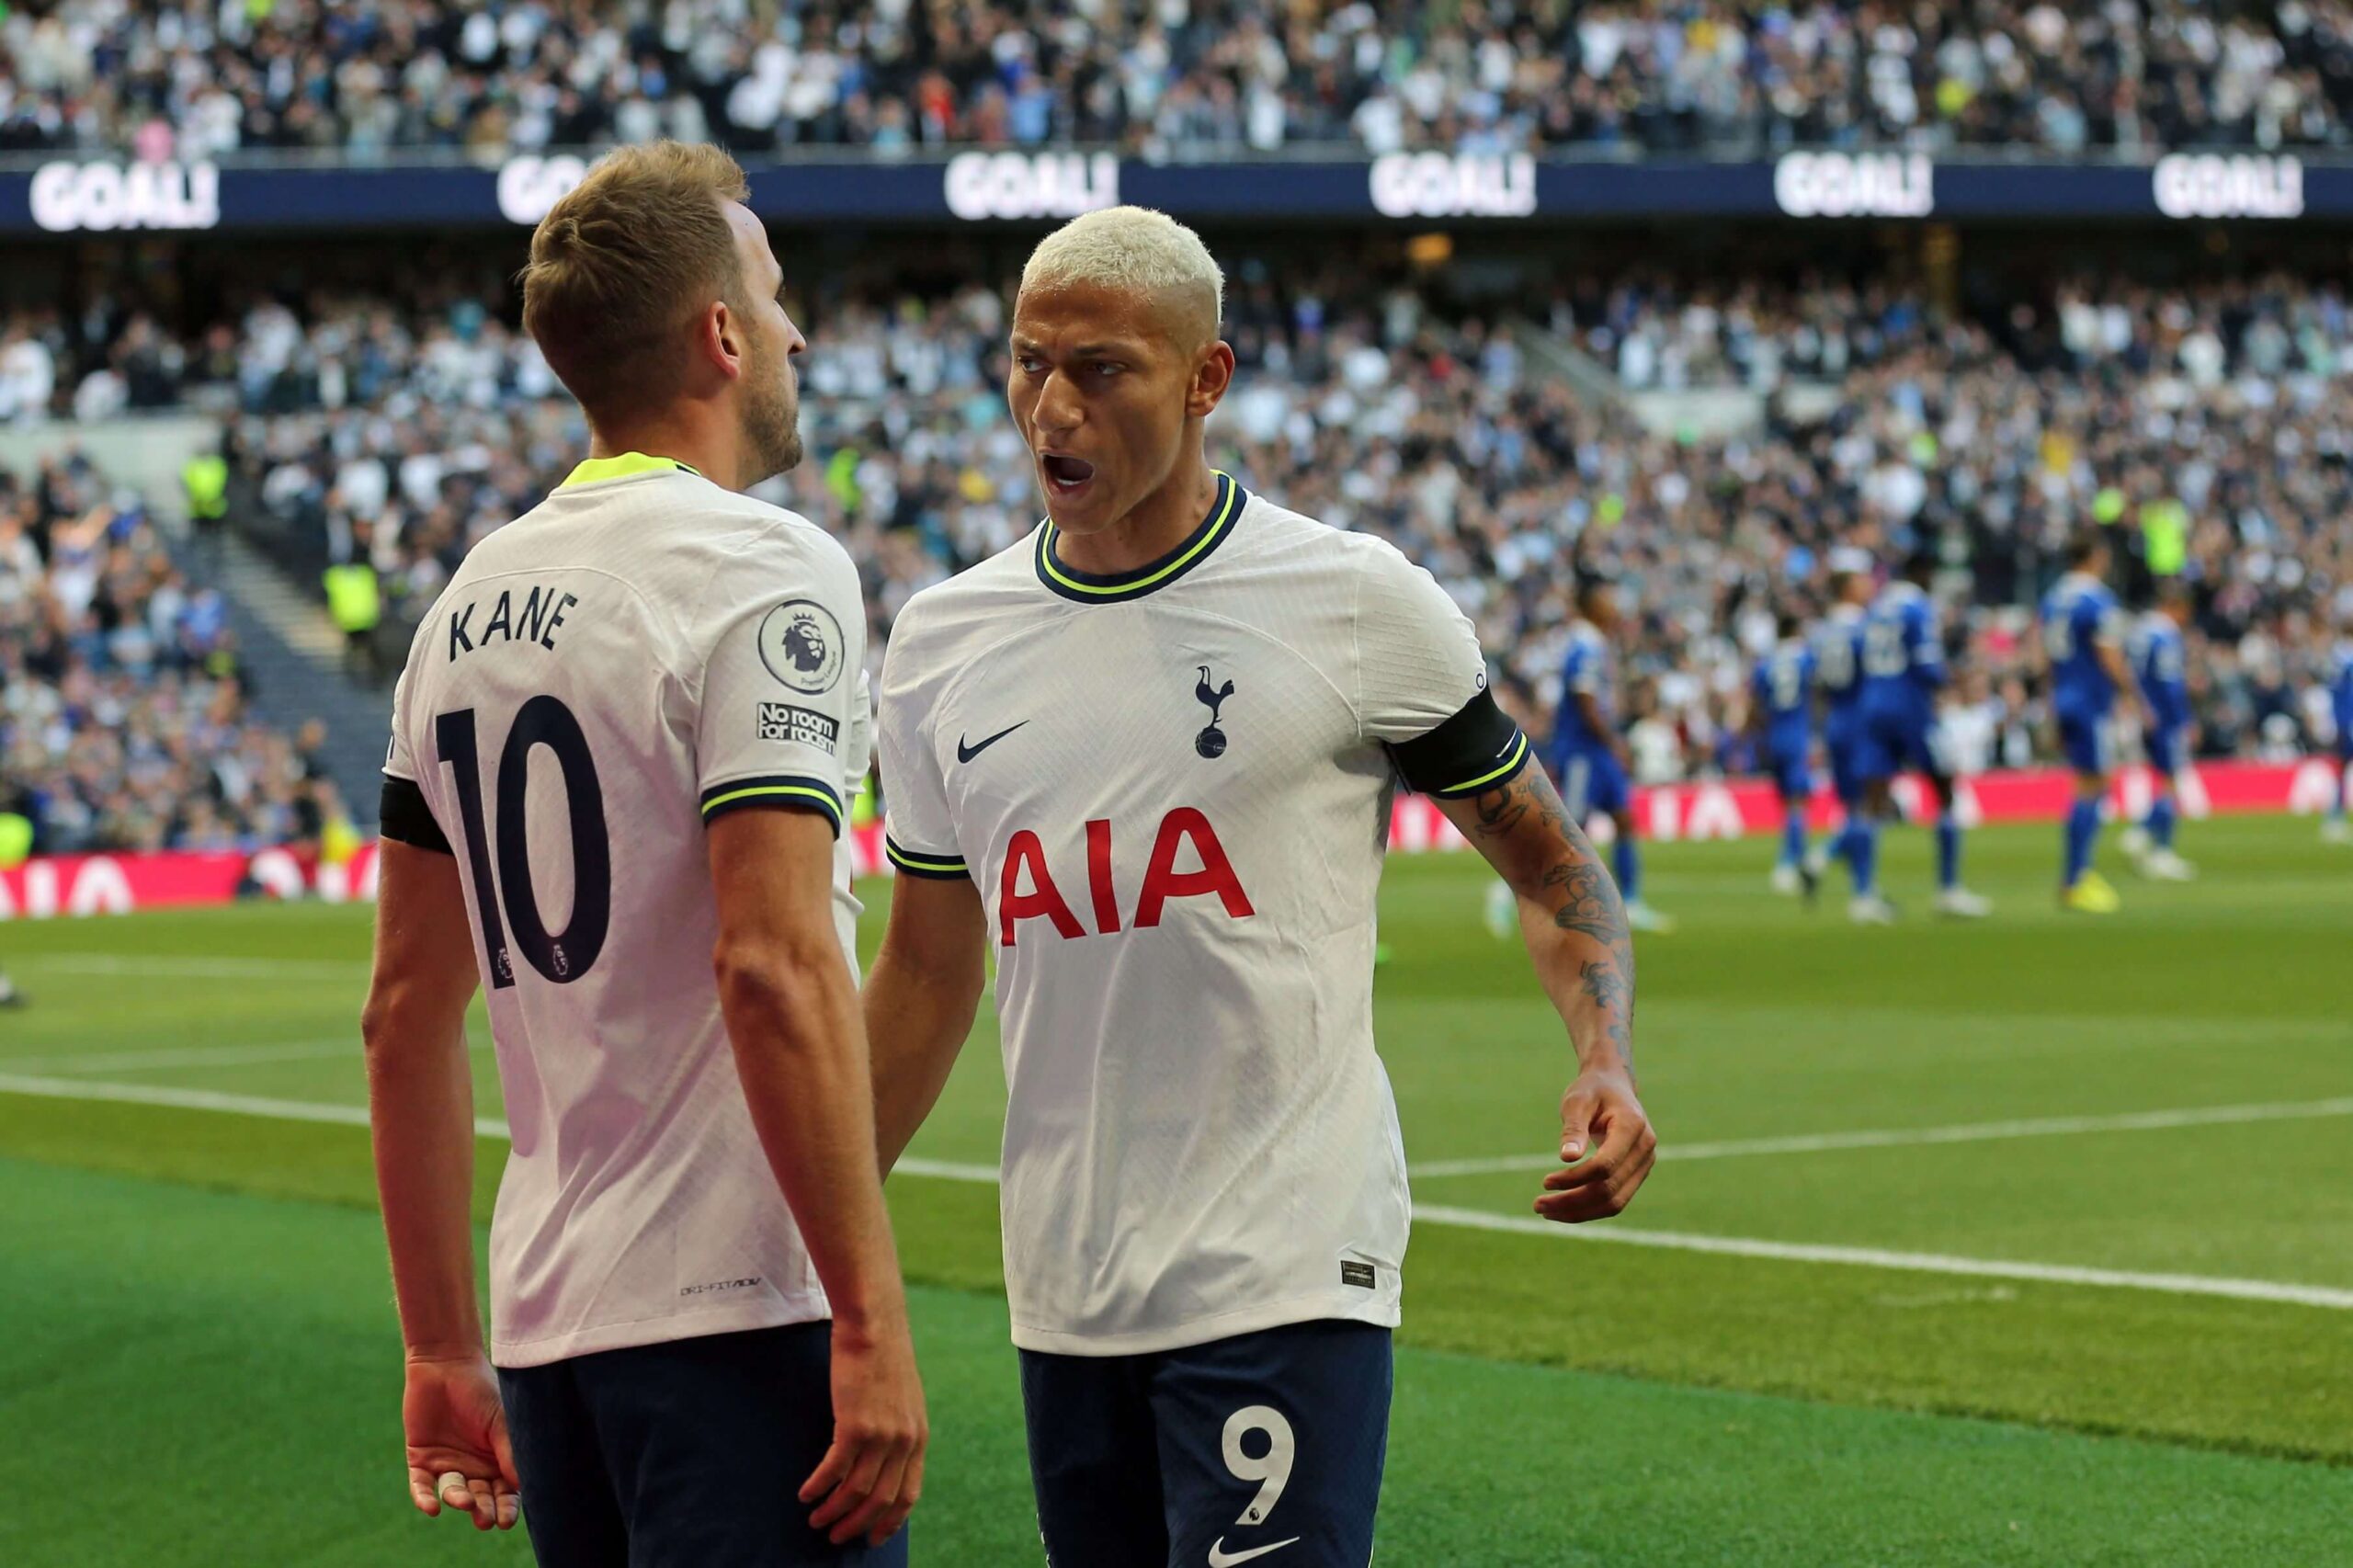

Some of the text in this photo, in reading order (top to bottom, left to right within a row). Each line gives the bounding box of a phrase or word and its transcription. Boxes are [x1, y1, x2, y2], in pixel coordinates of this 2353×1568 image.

[449, 585, 578, 663] KANE
[757, 719, 837, 757] for racism
[758, 703, 834, 738] No room
[436, 695, 611, 989] 10
[1000, 806, 1256, 948] AIA
[1221, 1404, 1295, 1526] 9
